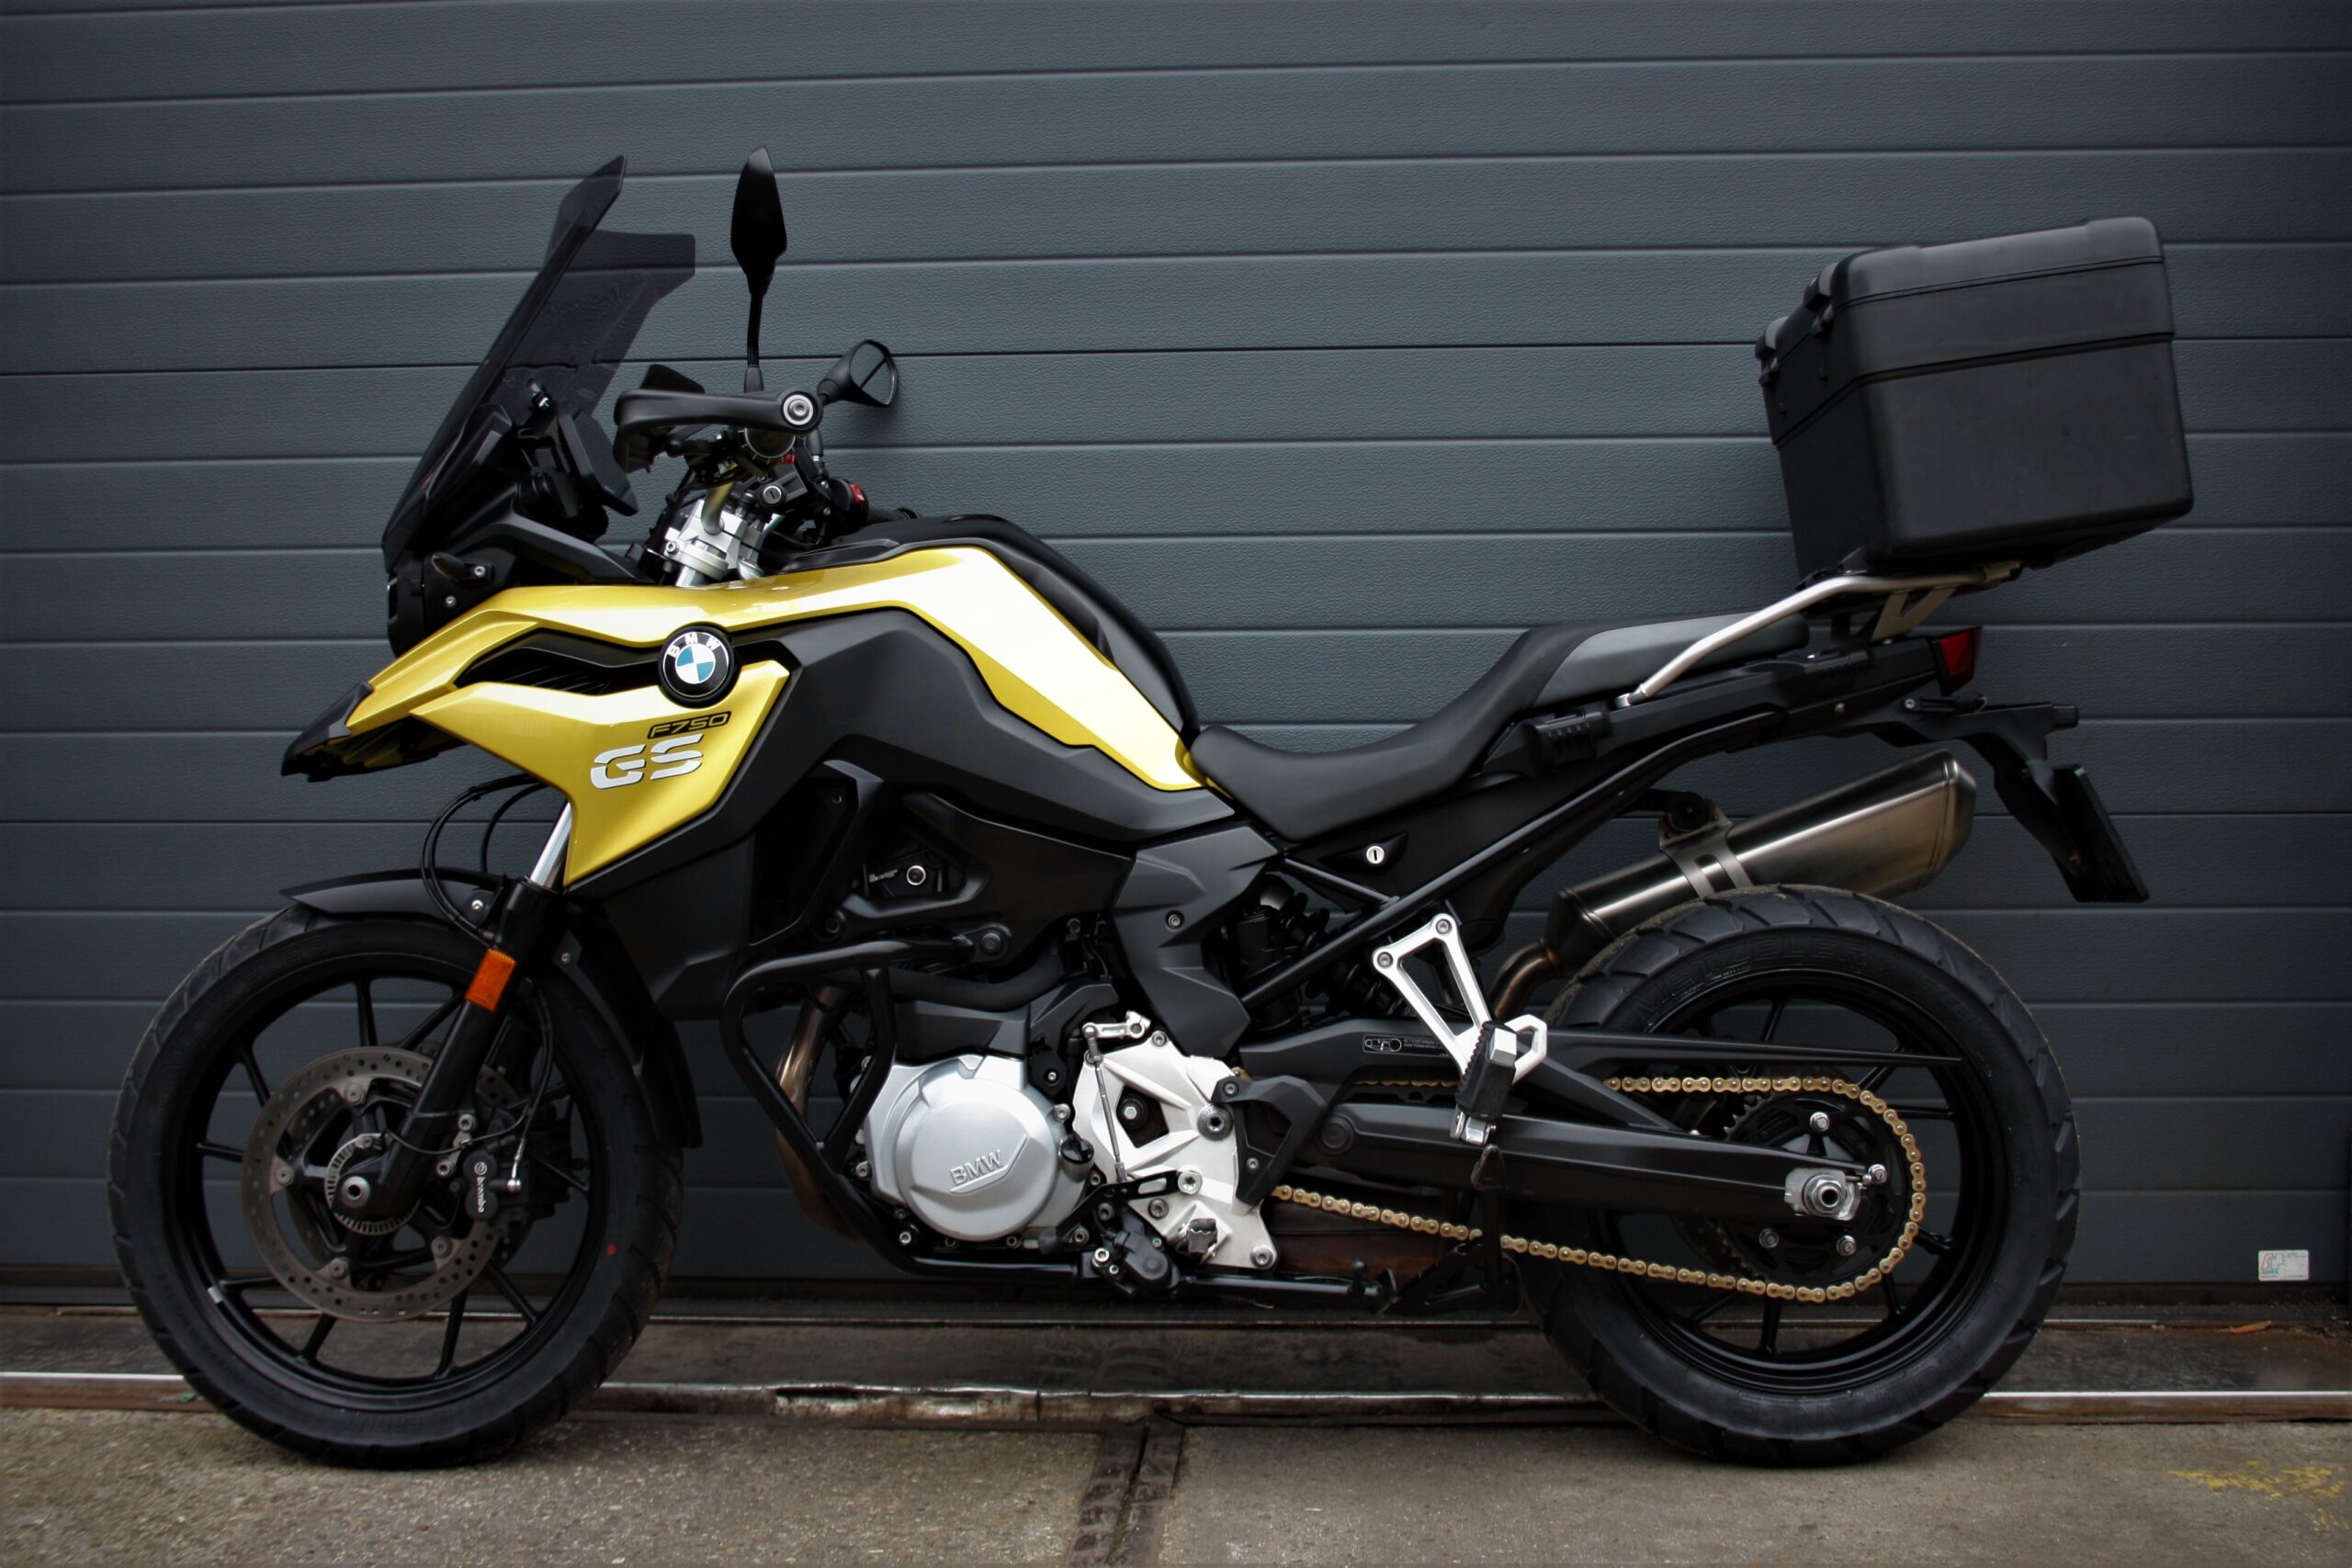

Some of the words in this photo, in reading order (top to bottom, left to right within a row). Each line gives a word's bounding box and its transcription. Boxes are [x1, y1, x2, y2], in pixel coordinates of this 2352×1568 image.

[668, 632, 720, 658] BMW
[651, 714, 728, 738] F750
[590, 733, 705, 789] GS
[1630, 935, 1868, 1020] METZELER
[949, 1148, 1003, 1187] BMW
